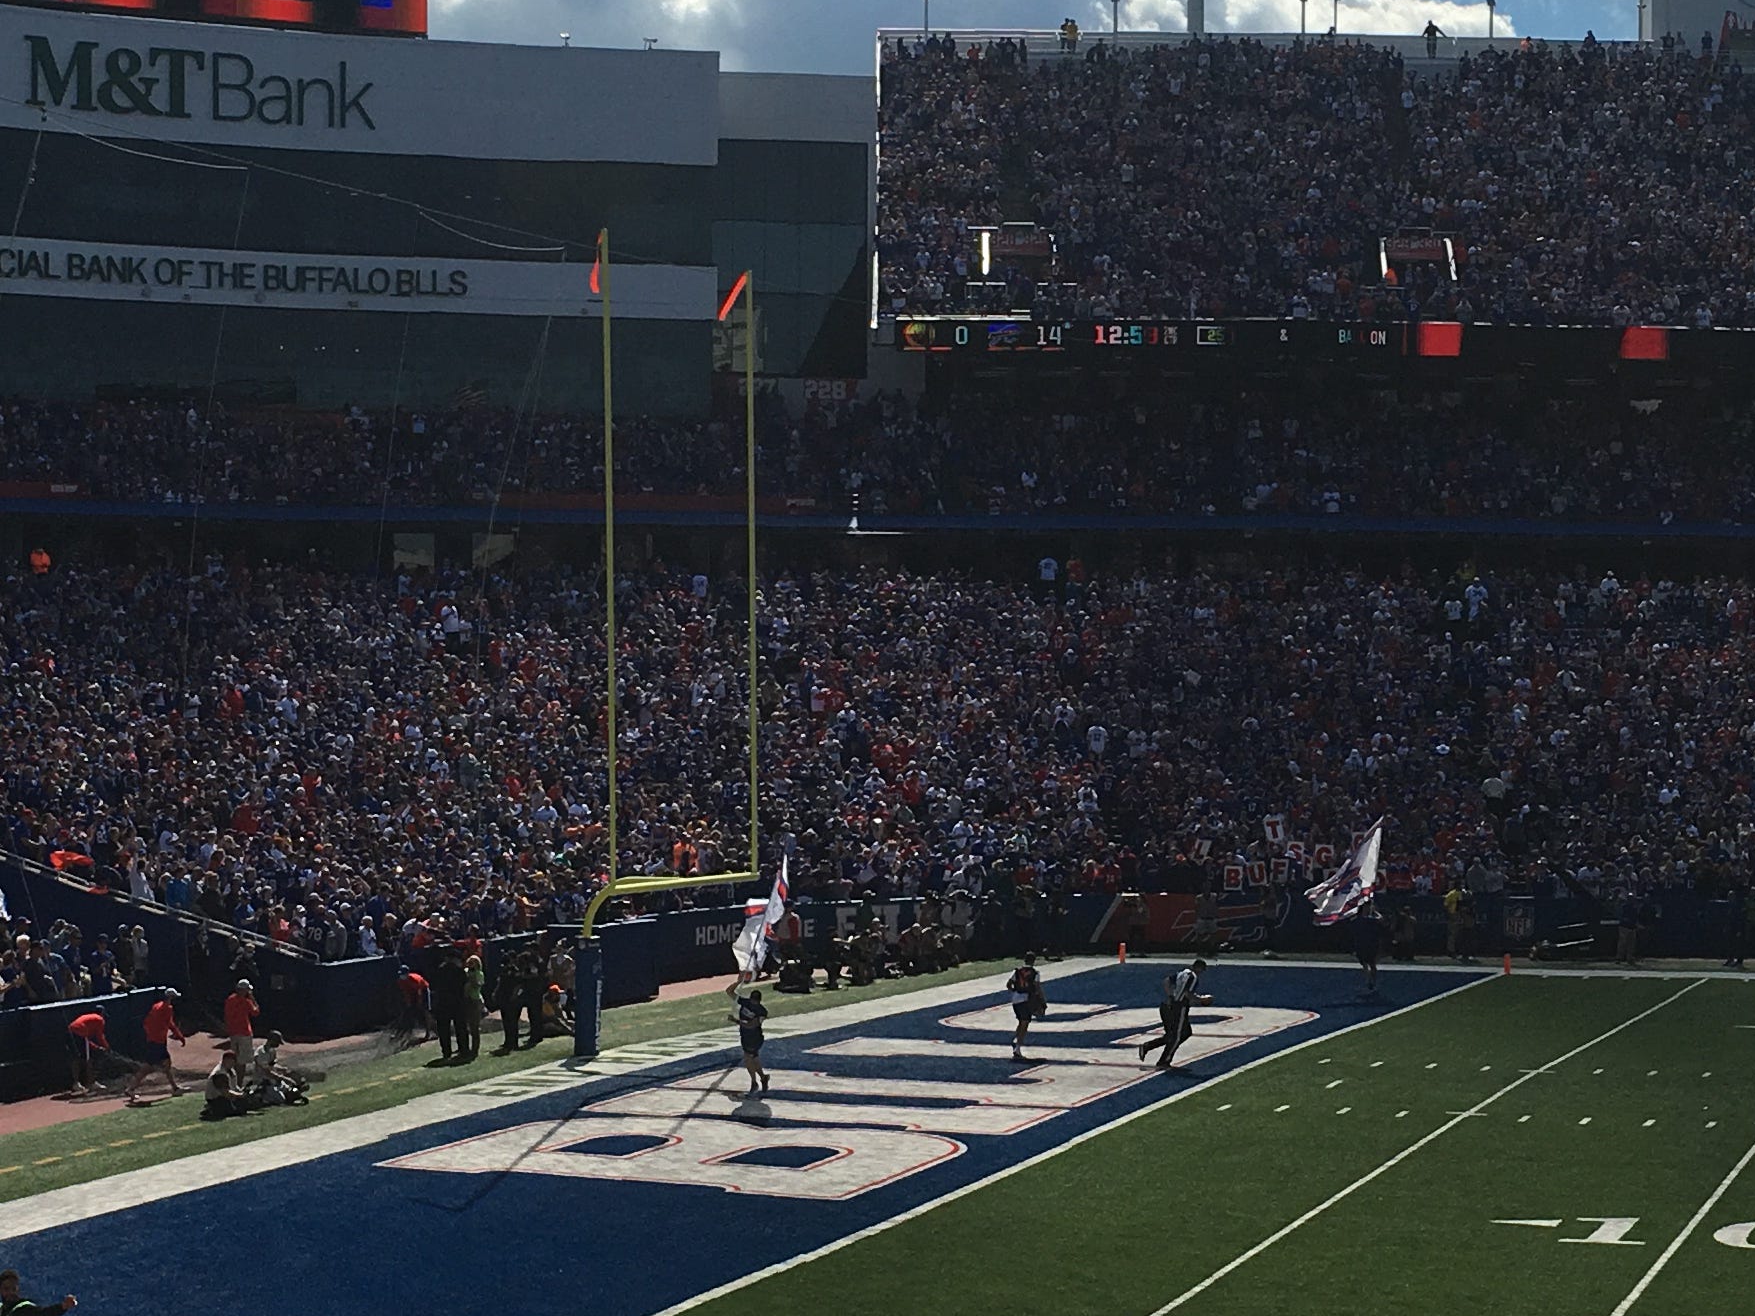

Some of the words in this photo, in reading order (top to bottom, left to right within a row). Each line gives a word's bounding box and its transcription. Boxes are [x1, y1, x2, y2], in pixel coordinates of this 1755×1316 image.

[24, 35, 205, 119] M&T
[212, 52, 376, 131] Bank
[68, 253, 147, 285] BANK
[155, 257, 192, 286] OF
[200, 261, 256, 290] THE
[262, 265, 391, 296] BUFFALO
[954, 325, 969, 345] 0
[1036, 325, 1062, 345] 14
[1370, 329, 1386, 345] ON
